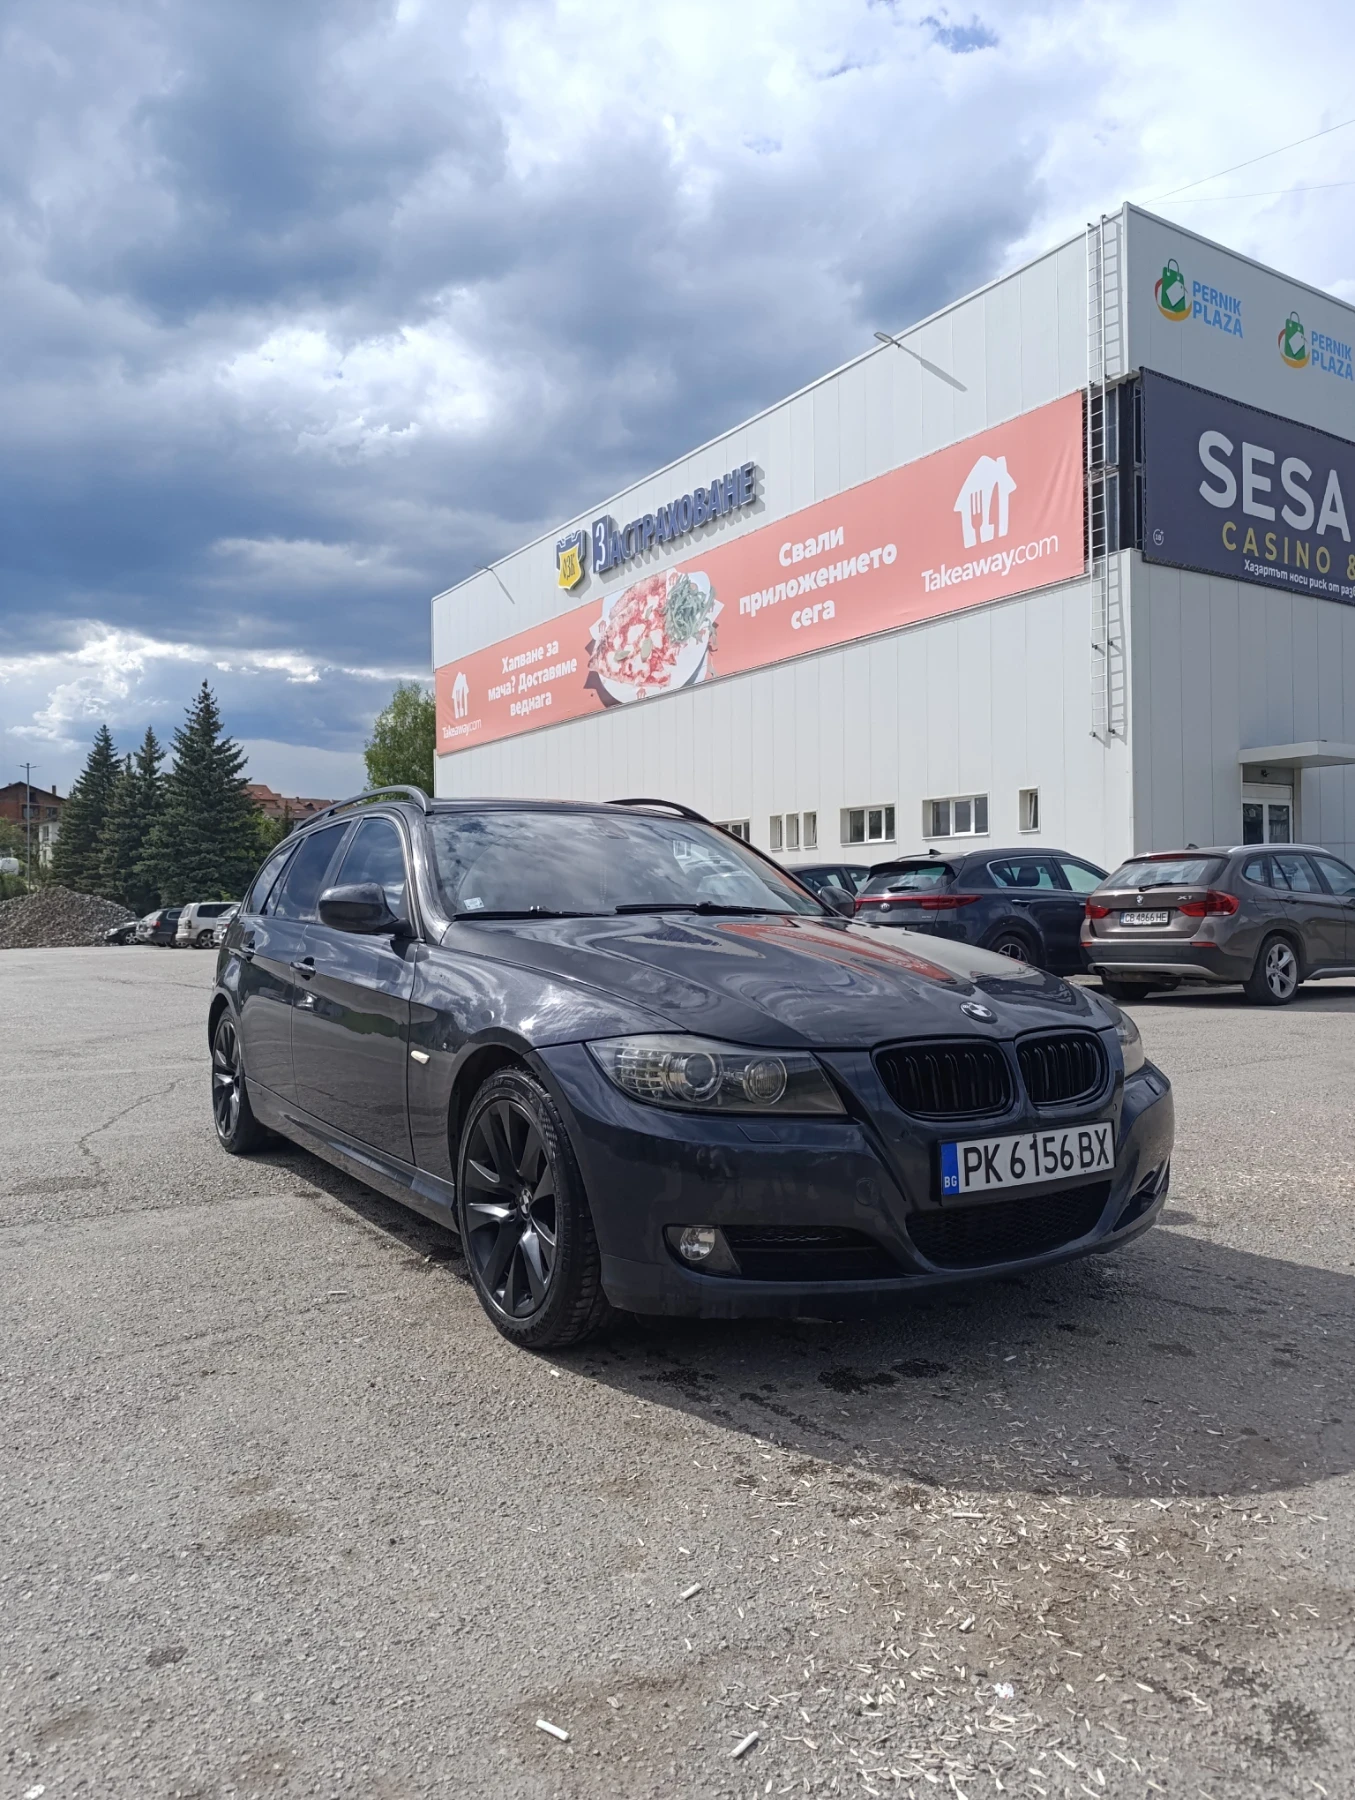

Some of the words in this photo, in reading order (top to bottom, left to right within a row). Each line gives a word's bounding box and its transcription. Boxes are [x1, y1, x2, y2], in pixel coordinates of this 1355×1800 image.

[1193, 280, 1242, 317] PERNIK
[1193, 300, 1244, 339] PLAZA
[1311, 331, 1352, 361] PERNIK
[1311, 349, 1354, 381] PLAZA
[1198, 430, 1351, 543] SESA
[778, 526, 844, 566] Свали
[921, 534, 1058, 592] Takeaway.com
[1222, 521, 1330, 574] CASINO
[739, 543, 897, 617] приложението
[1244, 559, 1288, 580] Хазартът
[1289, 573, 1308, 585] носи
[1309, 577, 1328, 590] риск
[1328, 583, 1339, 593] от
[791, 600, 835, 629] сега
[502, 646, 544, 674] Хапване
[546, 640, 559, 657] за
[488, 675, 516, 702] мача?
[518, 658, 577, 694] Доставяме
[510, 691, 552, 717] веднага
[442, 719, 482, 739] Takeaway.com
[944, 1175, 957, 1188] BG
